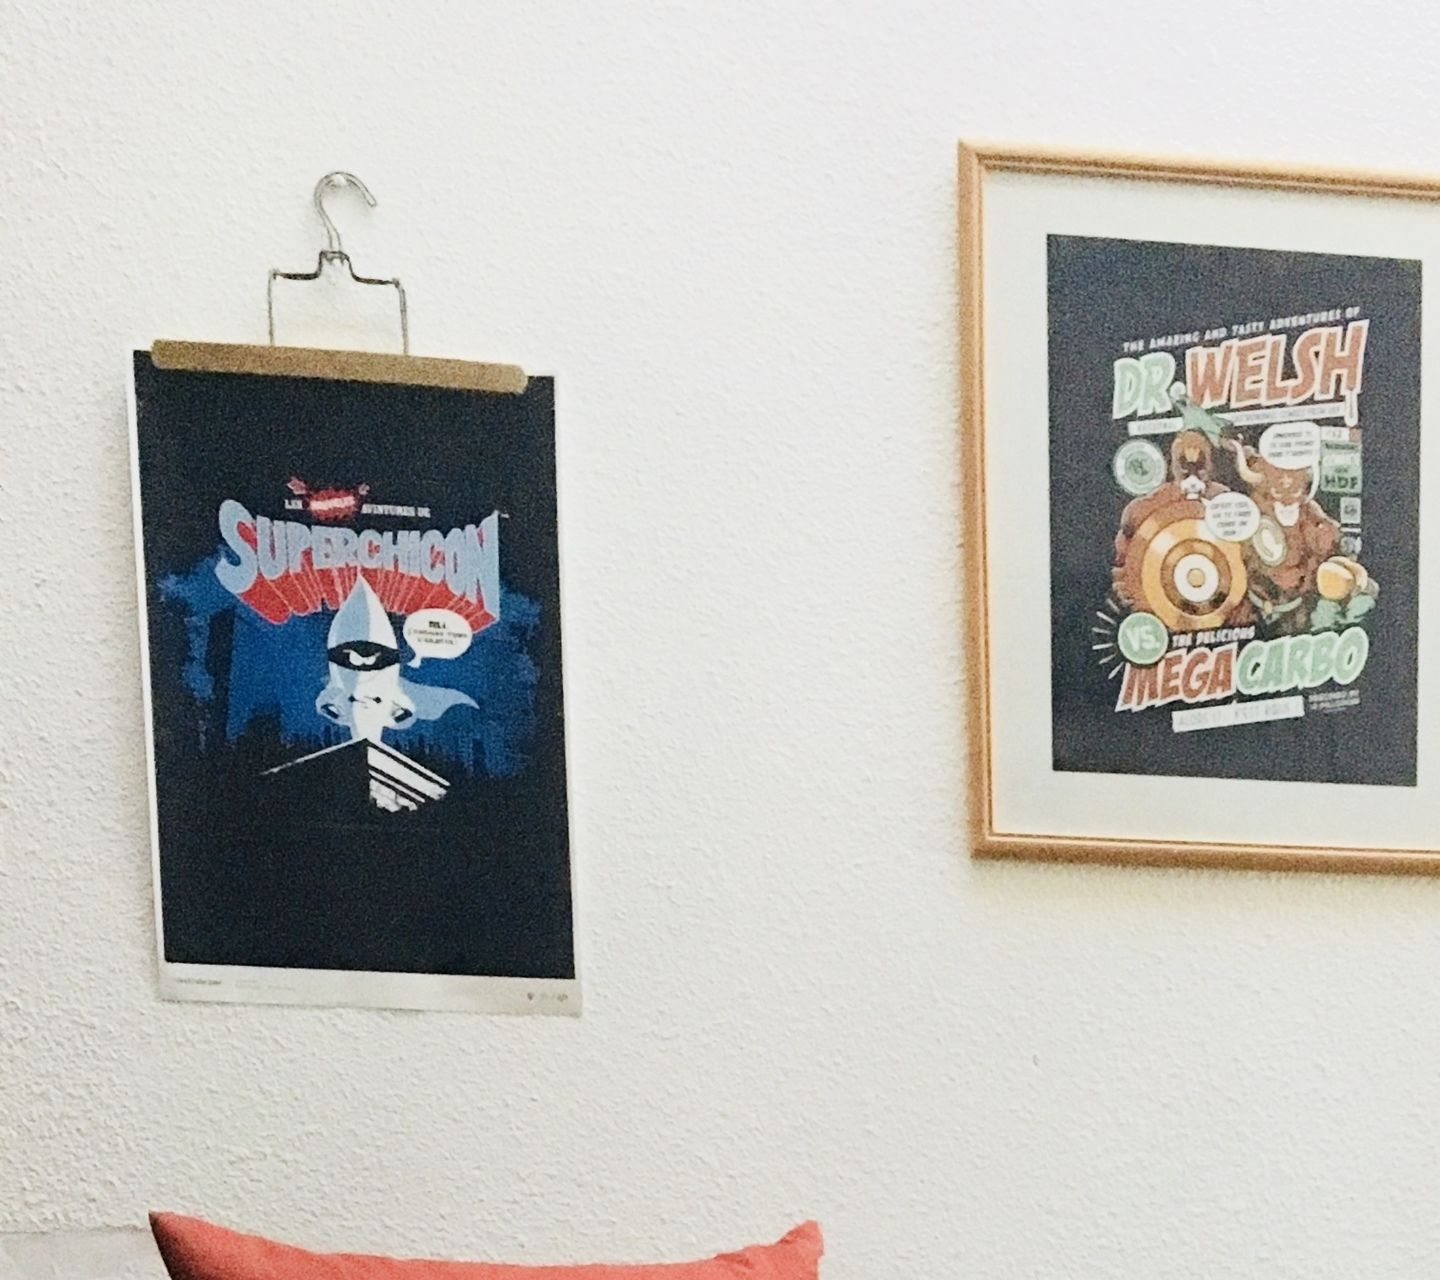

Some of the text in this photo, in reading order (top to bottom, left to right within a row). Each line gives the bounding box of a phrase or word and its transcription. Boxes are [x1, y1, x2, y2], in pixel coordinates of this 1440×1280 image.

[1112, 319, 1369, 419] DR. WELSH
[1204, 328, 1228, 341] AND
[1269, 309, 1343, 329] ADVENTURES
[215, 499, 500, 621] SUPERCHICON
[1114, 626, 1369, 712] MEGA CARBO
